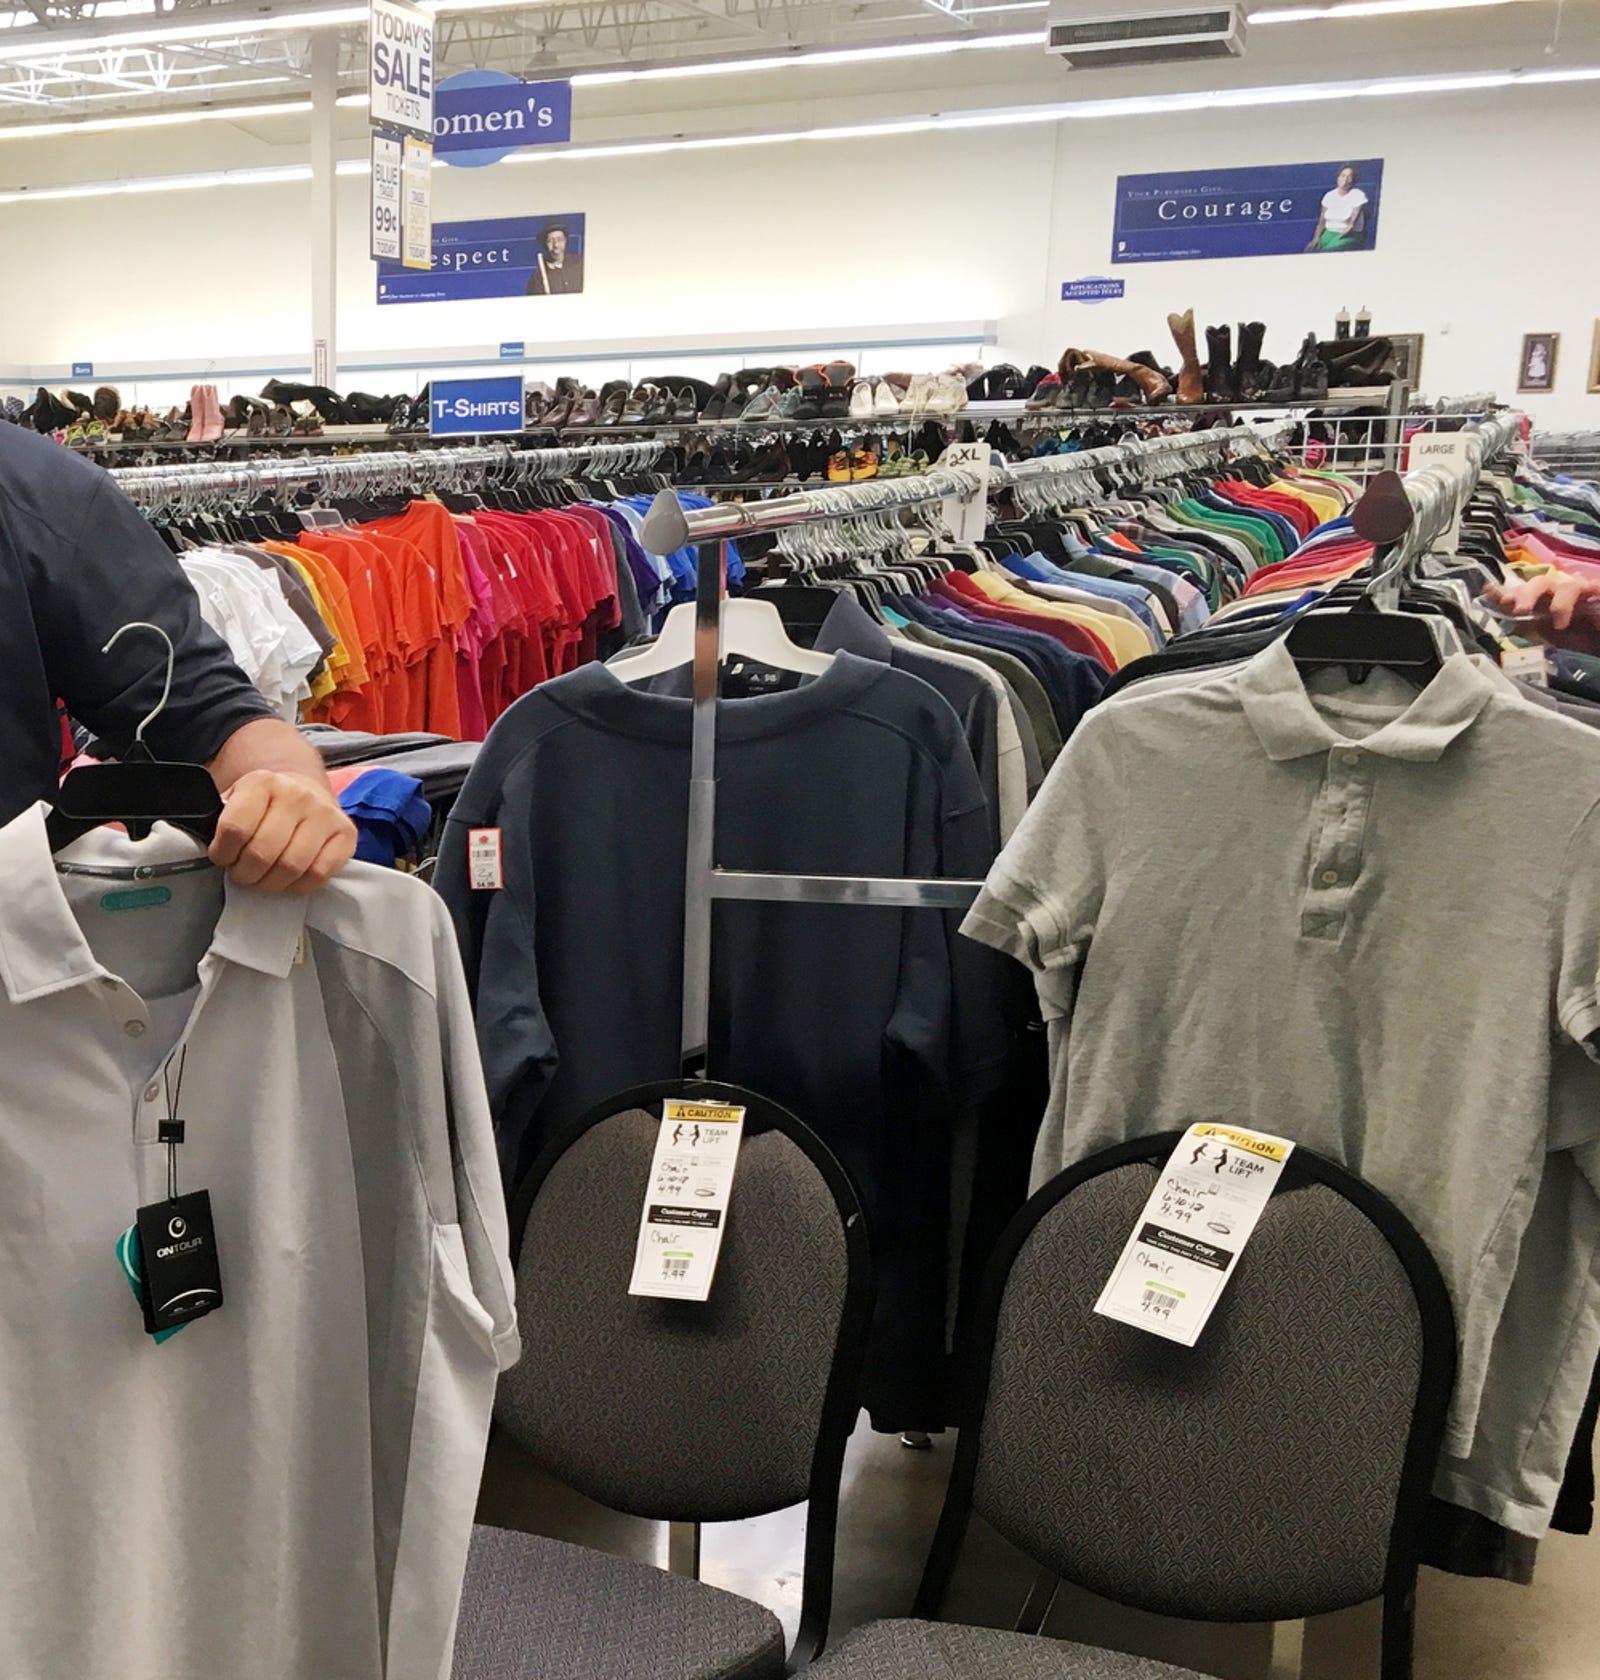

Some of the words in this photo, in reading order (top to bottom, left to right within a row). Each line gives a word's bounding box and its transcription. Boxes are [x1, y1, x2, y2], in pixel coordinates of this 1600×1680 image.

[374, 10, 431, 53] TODAY'S
[373, 42, 430, 99] SALE
[386, 92, 421, 120] TICKETS
[434, 98, 552, 136] omen's
[376, 163, 398, 185] BLUE
[1158, 197, 1293, 221] Courage
[431, 248, 510, 271] espect
[433, 398, 520, 419] T-SHIRTS
[1420, 444, 1456, 455] LARGE
[687, 1109, 732, 1119] CAUTION
[704, 1128, 728, 1136] TEAM
[1228, 1166, 1252, 1178] LIFT
[1233, 1157, 1265, 1174] TEAM
[1166, 1178, 1208, 1198] Chair
[651, 1229, 679, 1244] Chair
[1157, 1230, 1195, 1249] Customer
[1195, 1243, 1216, 1257] Copy
[156, 1237, 203, 1258] ONTOUR
[1137, 1251, 1174, 1274] Chair
[1141, 1302, 1172, 1321] 4.99
